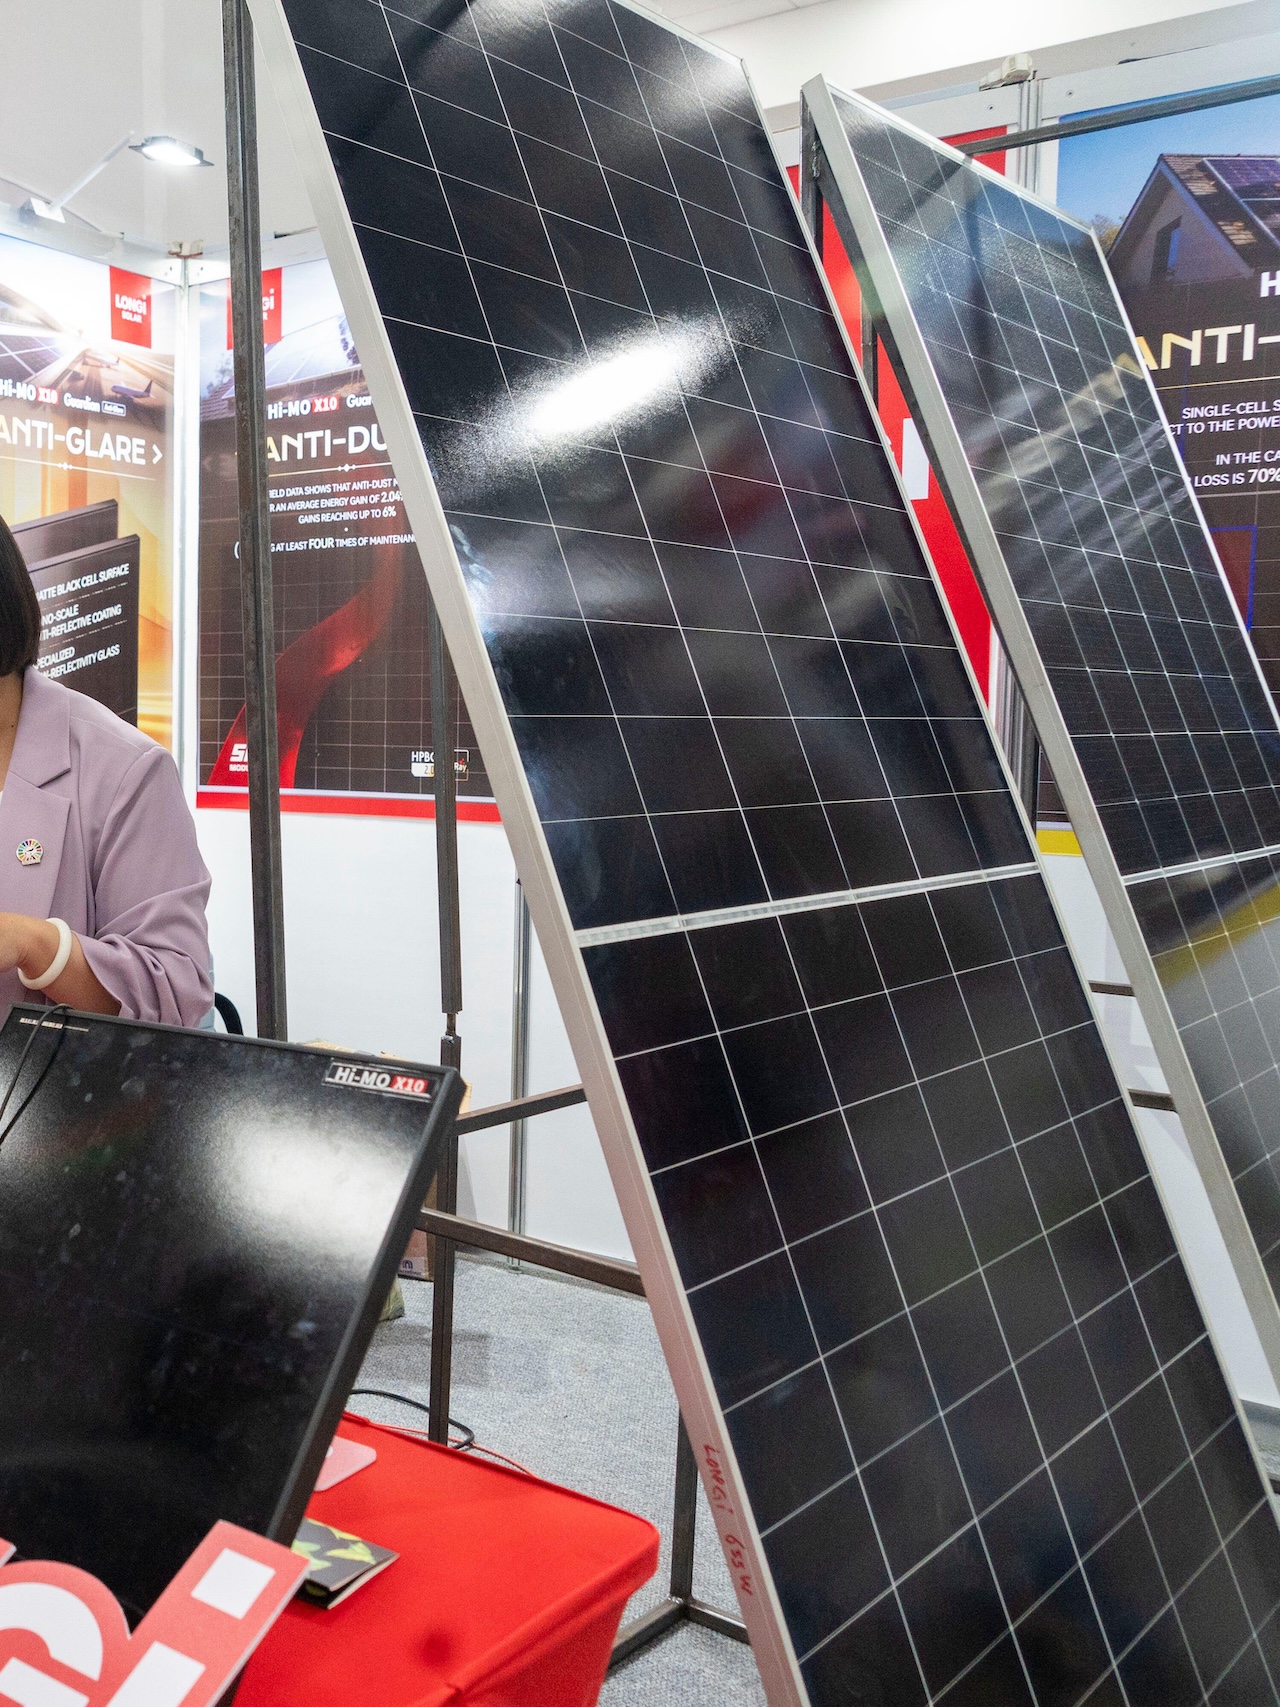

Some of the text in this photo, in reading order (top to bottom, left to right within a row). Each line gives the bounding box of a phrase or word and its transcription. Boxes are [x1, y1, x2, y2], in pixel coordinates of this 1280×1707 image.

[121, 310, 142, 323] SOLAR
[38, 387, 59, 404] X10
[64, 393, 100, 413] Guardian
[267, 399, 311, 420] Hi-MO
[314, 396, 338, 413] X10
[1182, 401, 1270, 419] SINGLE-CELL
[1186, 422, 1205, 434] TO
[1207, 419, 1235, 432] THE
[1238, 416, 1280, 430] POWE
[267, 424, 387, 462] ANTI-DU
[1216, 454, 1230, 465] IN
[1233, 451, 1261, 464] THE
[269, 489, 285, 498] IELD
[286, 487, 304, 497] DATA
[304, 484, 331, 495] SHOWS
[332, 482, 351, 492] THAT
[352, 478, 392, 491] ANTI-DUST
[1194, 474, 1230, 487] LOSS
[1232, 473, 1245, 484] IS
[276, 503, 287, 512] AN
[287, 499, 320, 511] AVERAGE
[320, 497, 349, 508] ENERGY
[350, 494, 368, 505] GAIN
[369, 494, 380, 504] OF
[298, 506, 397, 524] GAINS REACHING UP TO 6%
[276, 543, 285, 552] AT
[285, 541, 308, 552] LEAST
[308, 537, 335, 550] FOUR
[336, 538, 357, 548] TIMES
[358, 537, 369, 546] OF
[57, 577, 81, 596] BLACK
[81, 573, 99, 587] CELL
[99, 563, 129, 582] SURFACE
[40, 604, 122, 641] TI-REFLECTIVE COATING
[41, 604, 79, 626] NO-SCALE
[97, 644, 120, 661] GLASS
[334, 1066, 425, 1093] Hi-MO X10
